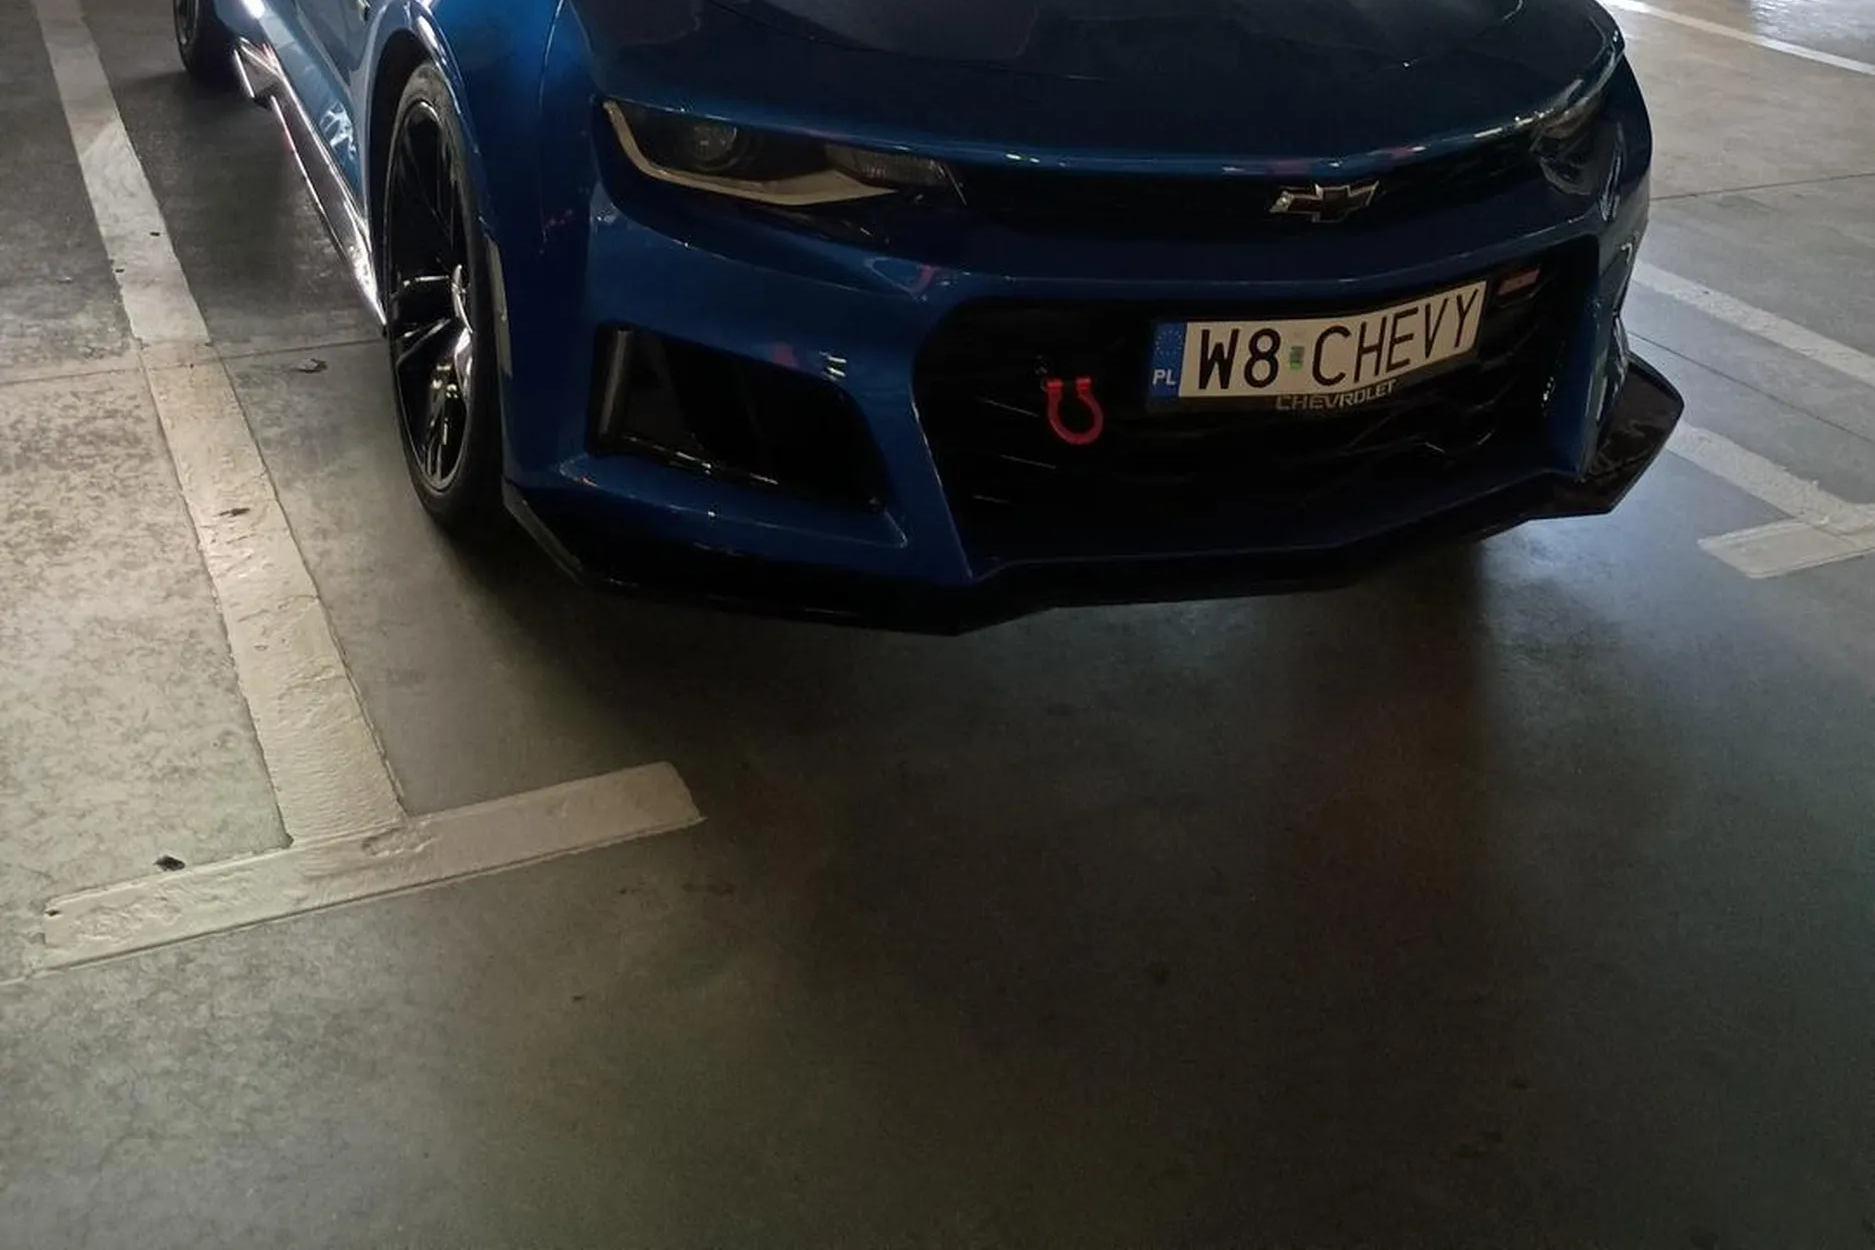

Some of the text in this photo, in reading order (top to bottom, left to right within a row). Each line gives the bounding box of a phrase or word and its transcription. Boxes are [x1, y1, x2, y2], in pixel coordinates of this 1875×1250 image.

[1198, 289, 1479, 390] W8 CHEVY
[1152, 368, 1178, 387] PL
[1275, 379, 1397, 411] CHEVROLET
